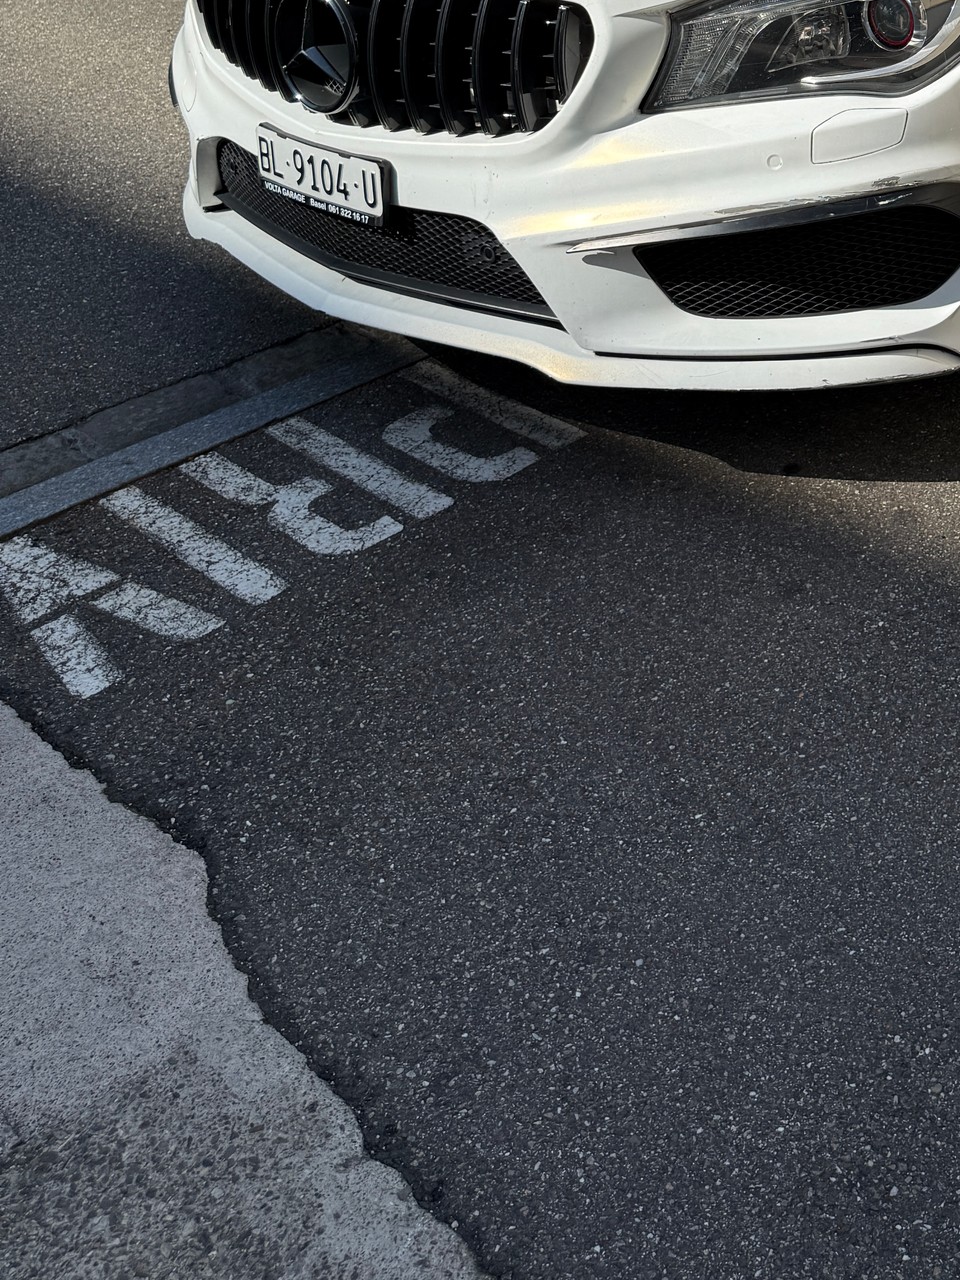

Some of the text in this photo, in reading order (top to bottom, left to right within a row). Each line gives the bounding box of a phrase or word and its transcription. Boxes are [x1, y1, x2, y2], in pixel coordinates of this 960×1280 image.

[264, 181, 282, 195] VOLTA
[282, 186, 306, 204] GARAGE
[310, 198, 327, 211] Basel
[340, 208, 352, 219] 322
[361, 215, 369, 225] 17
